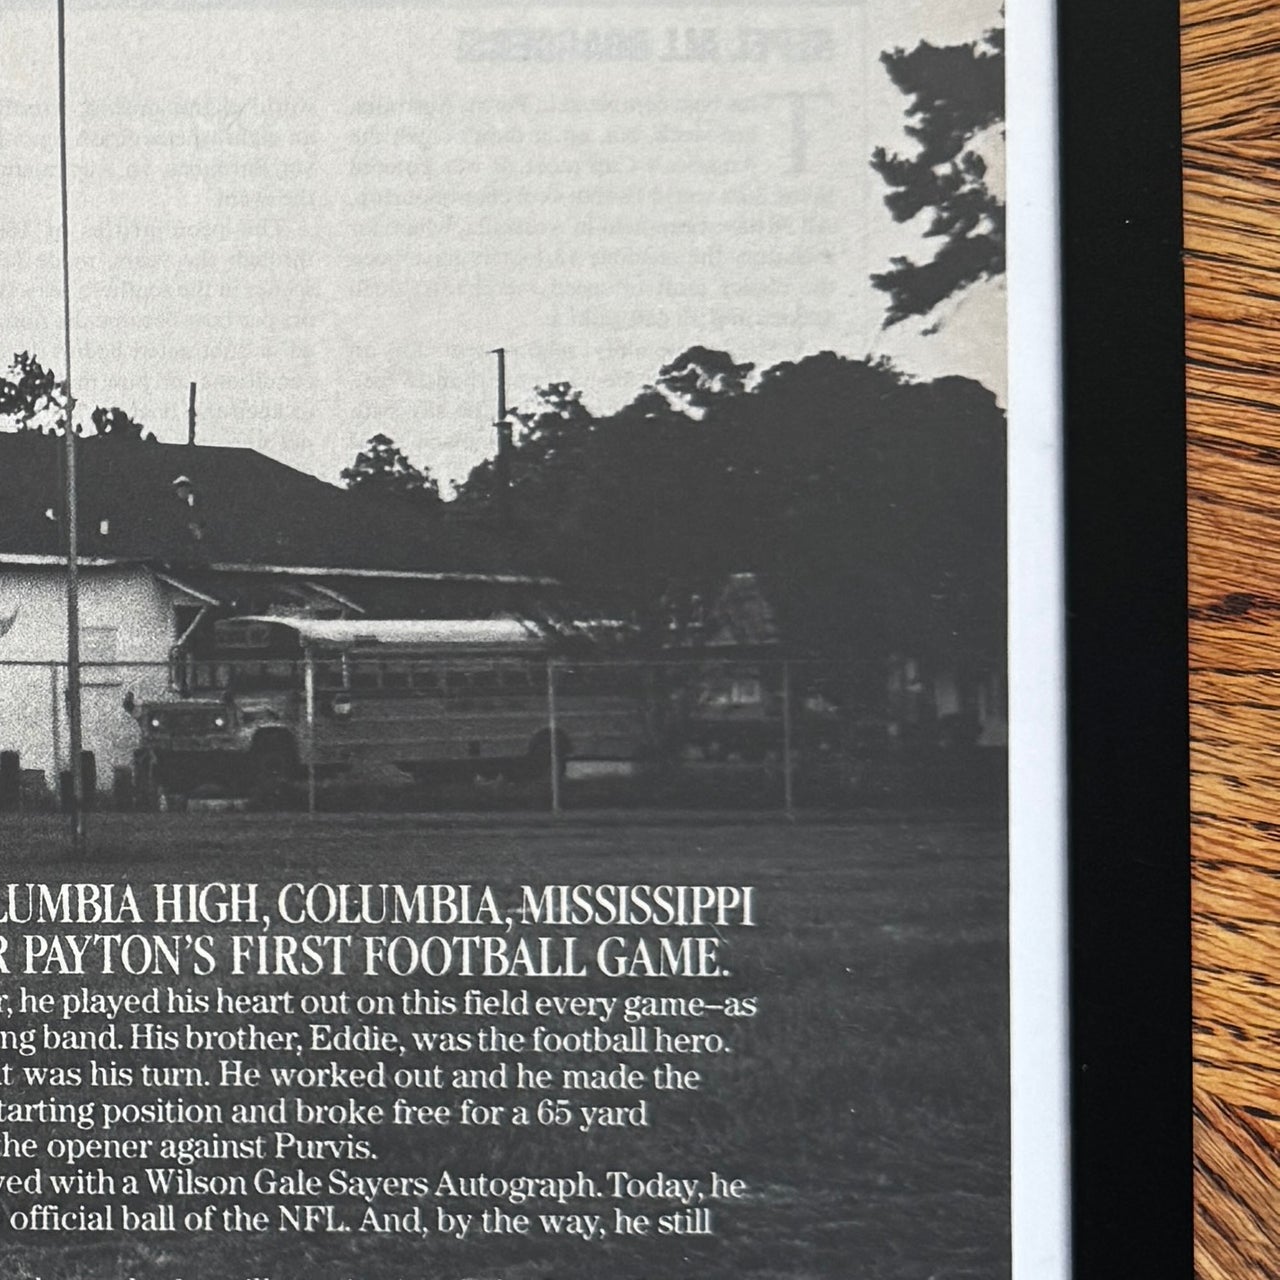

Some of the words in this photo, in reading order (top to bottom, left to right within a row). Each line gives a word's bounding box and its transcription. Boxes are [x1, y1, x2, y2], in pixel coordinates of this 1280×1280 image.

[154, 882, 270, 931] HIGH,
[278, 883, 513, 932] COLUMBIA,
[520, 884, 755, 926] MISSISSIPPI
[24, 934, 216, 975] PAYTON'S
[232, 935, 351, 975] FIRST
[364, 936, 587, 976] FOOTBALL
[597, 937, 730, 977] GAME.
[20, 987, 54, 1013] he
[62, 988, 160, 1019] played
[167, 987, 209, 1013] his
[217, 987, 294, 1014] heart
[301, 992, 349, 1014] out
[357, 996, 395, 1014] on
[402, 989, 457, 1015] this
[464, 990, 529, 1015] field
[535, 997, 617, 1022] every
[43, 1024, 123, 1049] band.
[131, 1024, 179, 1050] His
[186, 1024, 302, 1056] brother,
[309, 1025, 406, 1056] Eddie,
[412, 1033, 472, 1051] was
[478, 1026, 525, 1052] the
[533, 1026, 648, 1052] football
[655, 1027, 730, 1053] hero.
[23, 1068, 82, 1086] was
[90, 1060, 133, 1086] his
[141, 1065, 210, 1086] turn.
[219, 1060, 261, 1086] He
[271, 1062, 386, 1087] worked
[394, 1066, 443, 1088] out
[452, 1063, 507, 1088] and
[517, 1063, 552, 1088] he
[563, 1064, 645, 1089] made
[654, 1063, 701, 1089] the
[47, 1139, 153, 1164] opener
[160, 1133, 265, 1165] against
[275, 1132, 377, 1159] Purvis.
[49, 1169, 115, 1195] with
[122, 1176, 139, 1194] a
[145, 1169, 247, 1195] Wilson
[254, 1168, 322, 1195] Gale
[329, 1169, 429, 1202] Sayers
[435, 1171, 602, 1204] Autograph.
[606, 1172, 704, 1204] Today,
[711, 1172, 747, 1198] he
[10, 1204, 114, 1231] official
[122, 1205, 176, 1231] ball
[185, 1205, 217, 1231] of
[223, 1205, 269, 1231] the
[279, 1205, 350, 1232] NFL.
[359, 1207, 428, 1238] And,
[437, 1207, 472, 1239] by
[482, 1207, 530, 1234] the
[539, 1215, 606, 1240] way,
[615, 1208, 650, 1234] he
[658, 1208, 712, 1234] still
